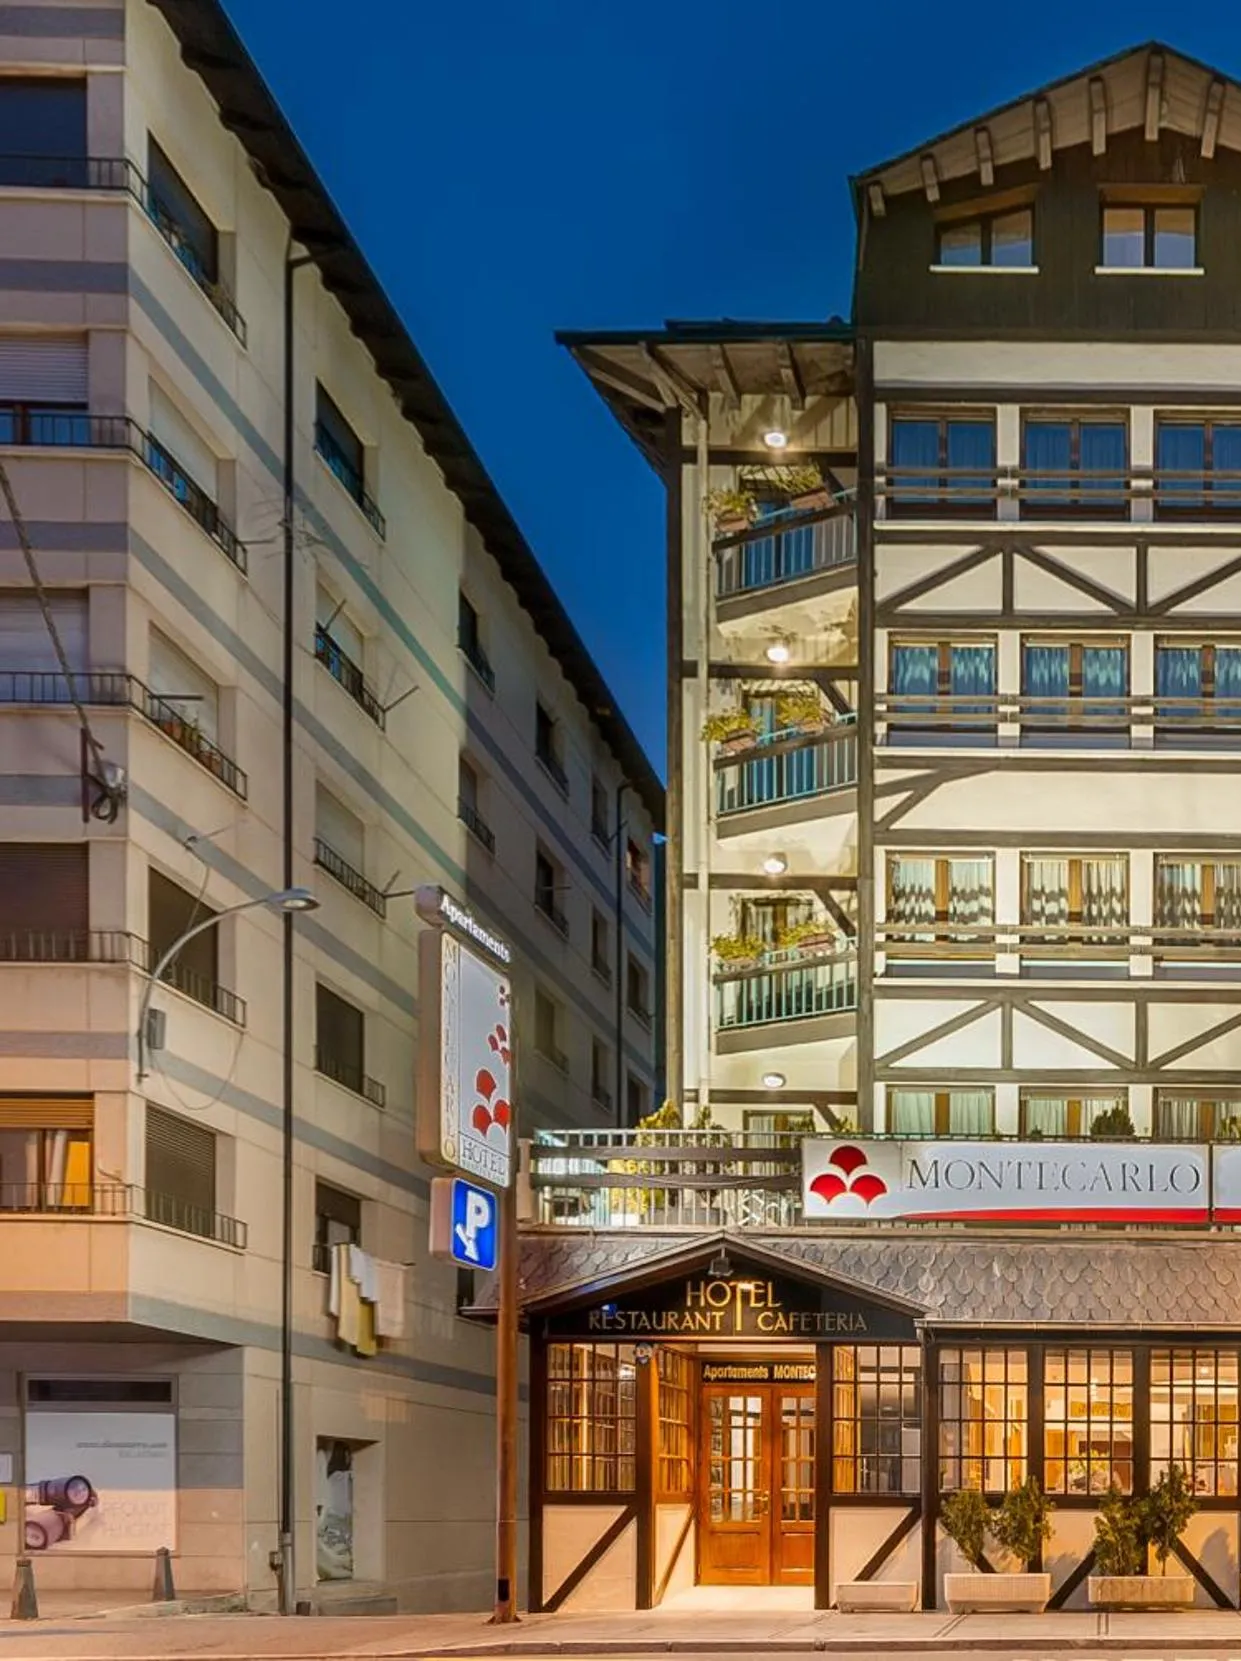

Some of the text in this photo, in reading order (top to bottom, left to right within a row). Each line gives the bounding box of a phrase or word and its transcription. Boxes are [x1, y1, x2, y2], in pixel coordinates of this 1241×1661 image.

[440, 893, 510, 963] Apartaments
[462, 1138, 506, 1177] HOTEL
[906, 1158, 1202, 1194] MONTECARLO
[466, 1190, 491, 1240] P
[589, 1311, 868, 1331] RESTAURANT CAFETERIA
[686, 1281, 782, 1331] HOTEL
[703, 1364, 769, 1381] Apartaments
